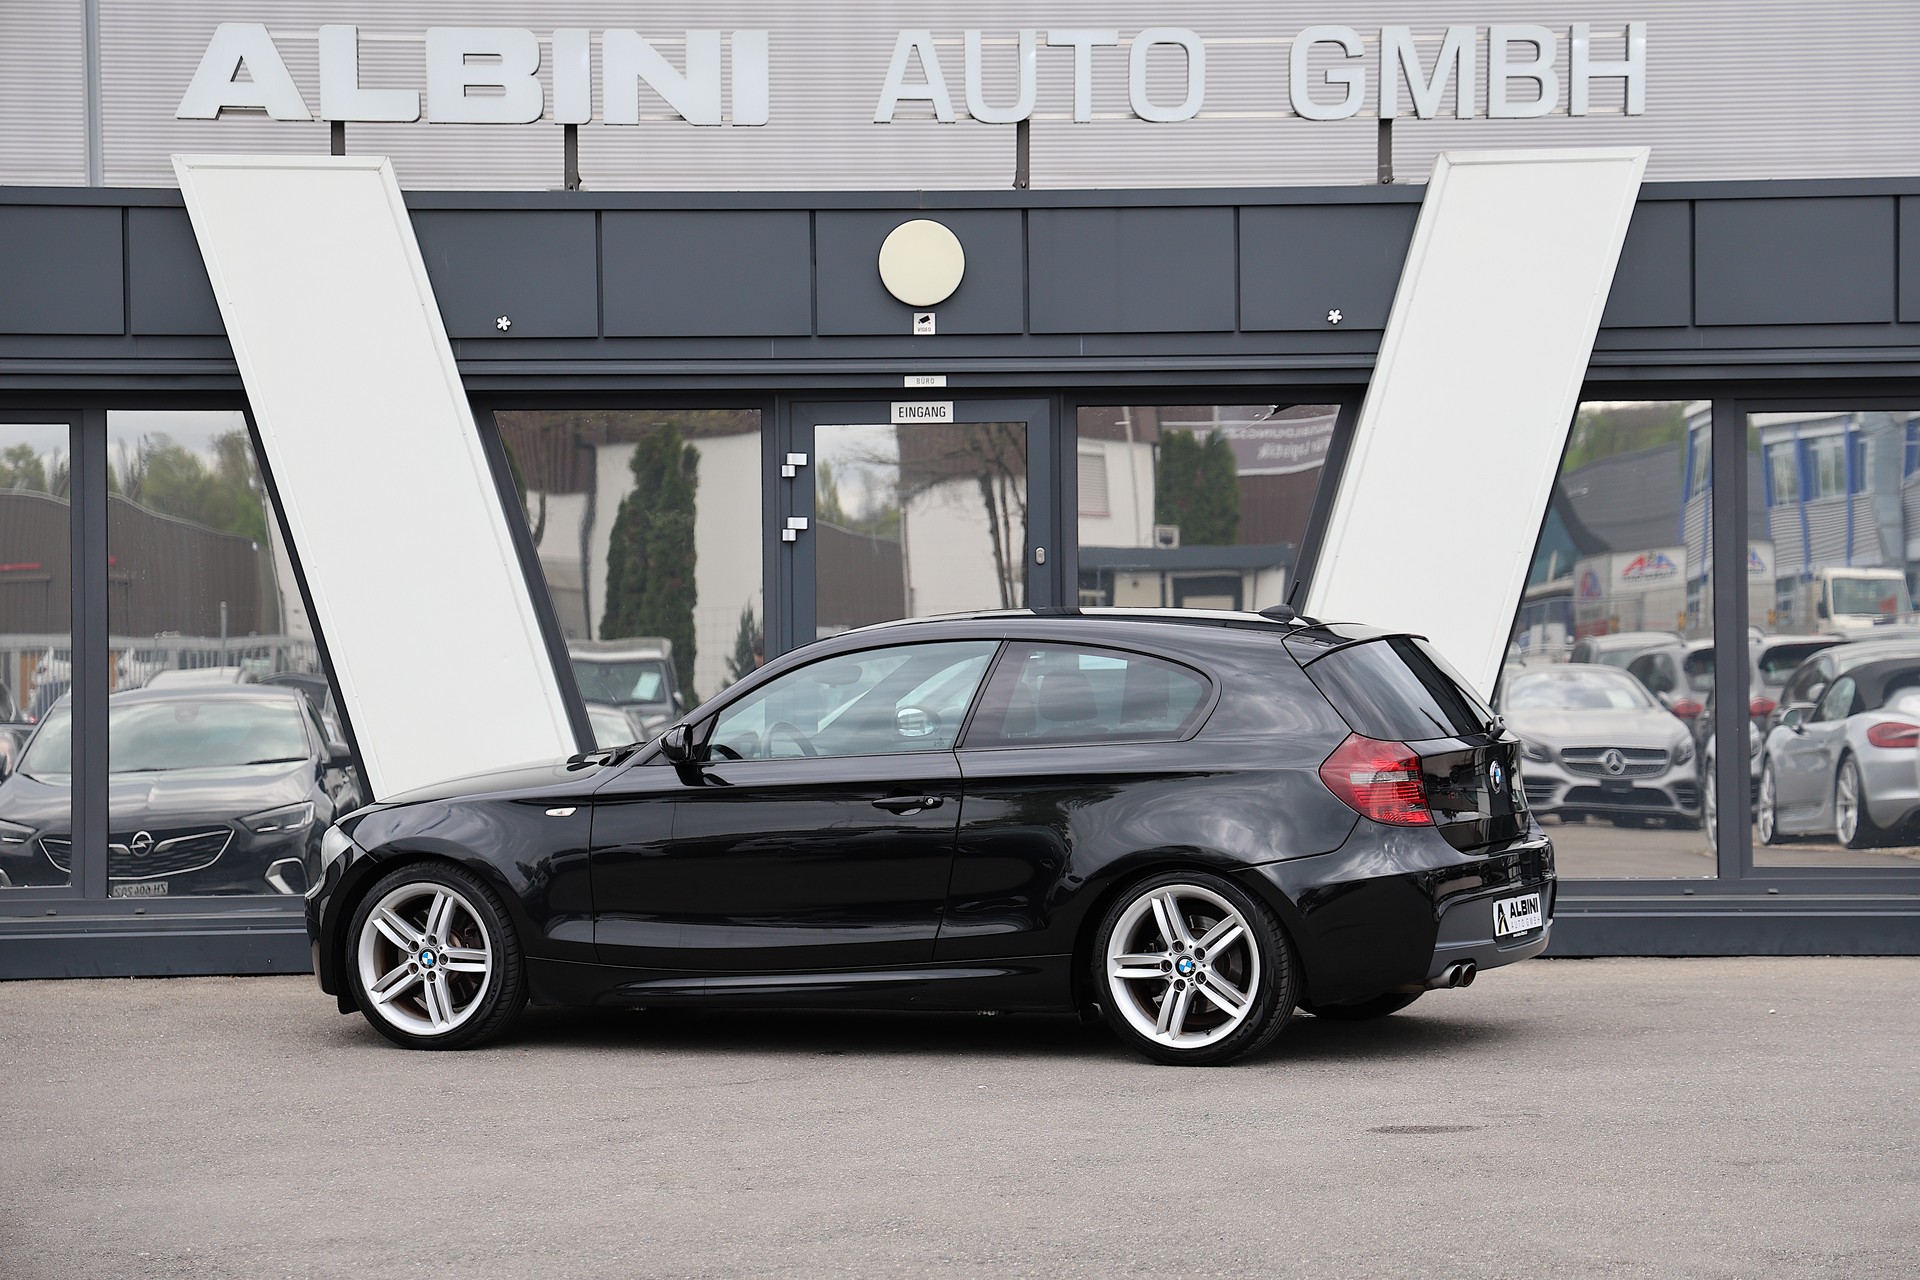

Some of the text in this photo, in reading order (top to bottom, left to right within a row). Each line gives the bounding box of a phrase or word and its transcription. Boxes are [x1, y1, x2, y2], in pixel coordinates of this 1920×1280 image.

[175, 21, 1648, 127] ALBINI AUTO GMBH
[916, 376, 935, 385] BÜRO
[898, 405, 946, 418] EINGANG
[1510, 897, 1538, 918] ALBINI
